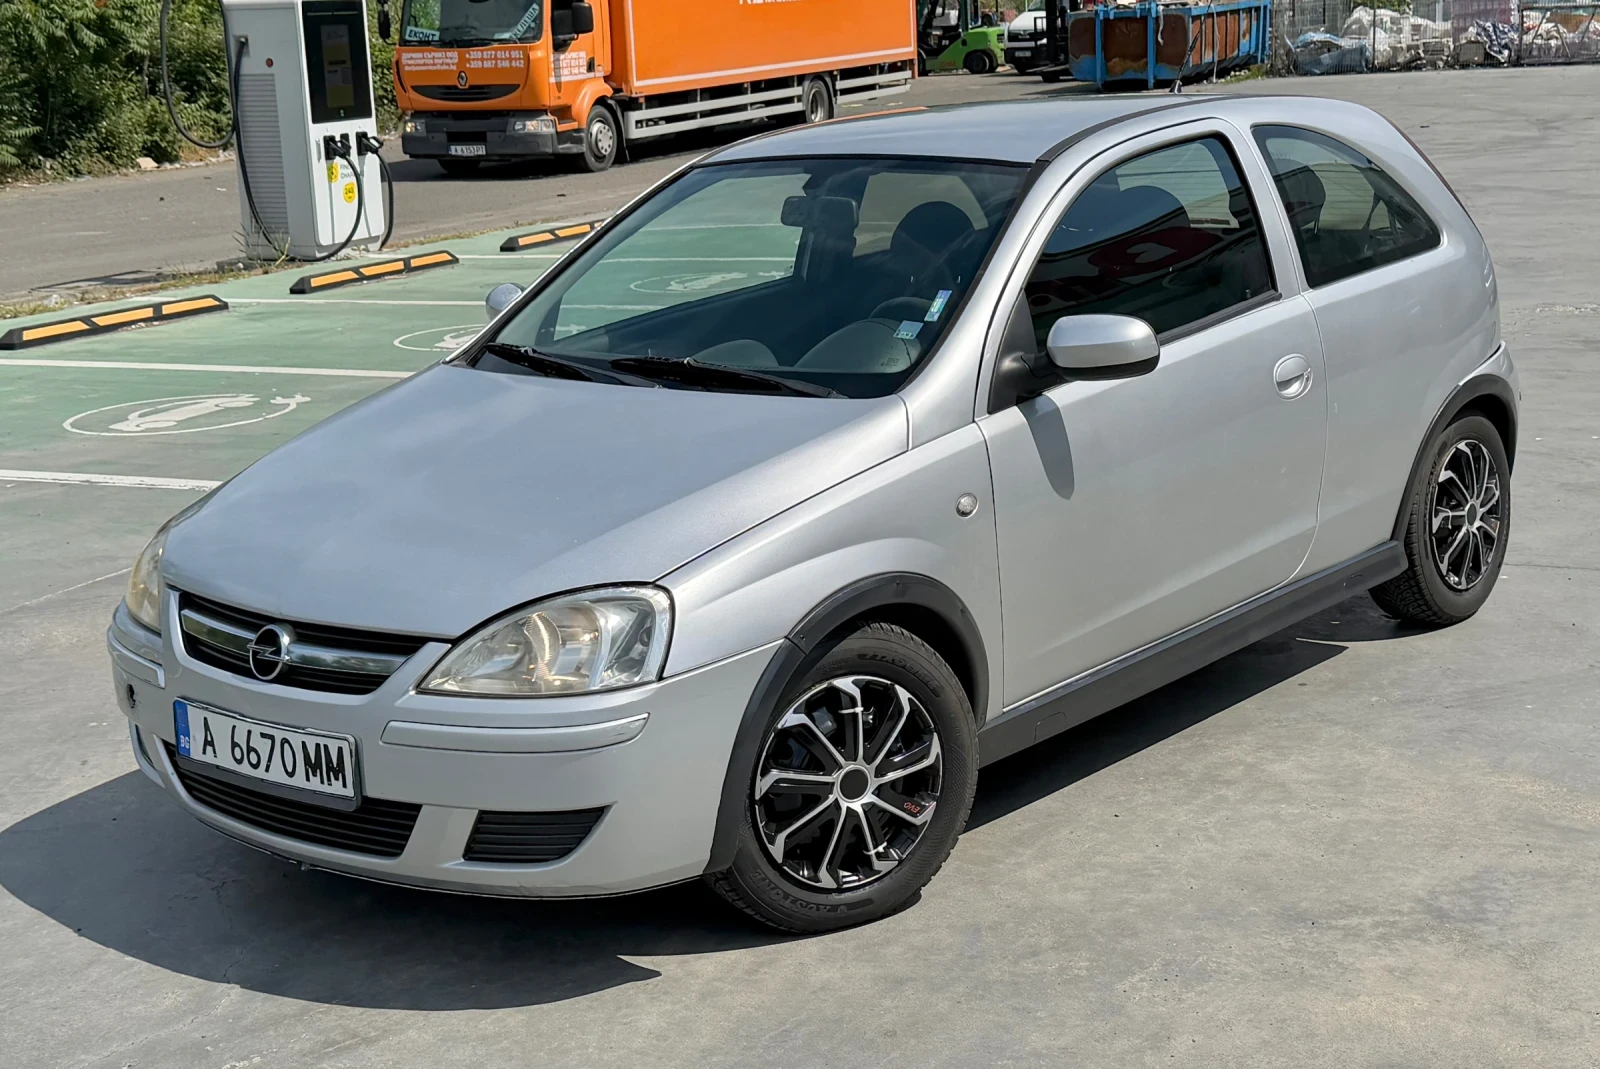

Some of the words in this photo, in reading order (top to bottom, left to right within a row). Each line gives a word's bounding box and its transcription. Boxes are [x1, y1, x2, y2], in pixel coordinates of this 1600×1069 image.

[408, 29, 436, 41] ЕКОНТ
[179, 734, 190, 749] BG
[202, 716, 218, 758] A
[903, 801, 921, 813] EVO
